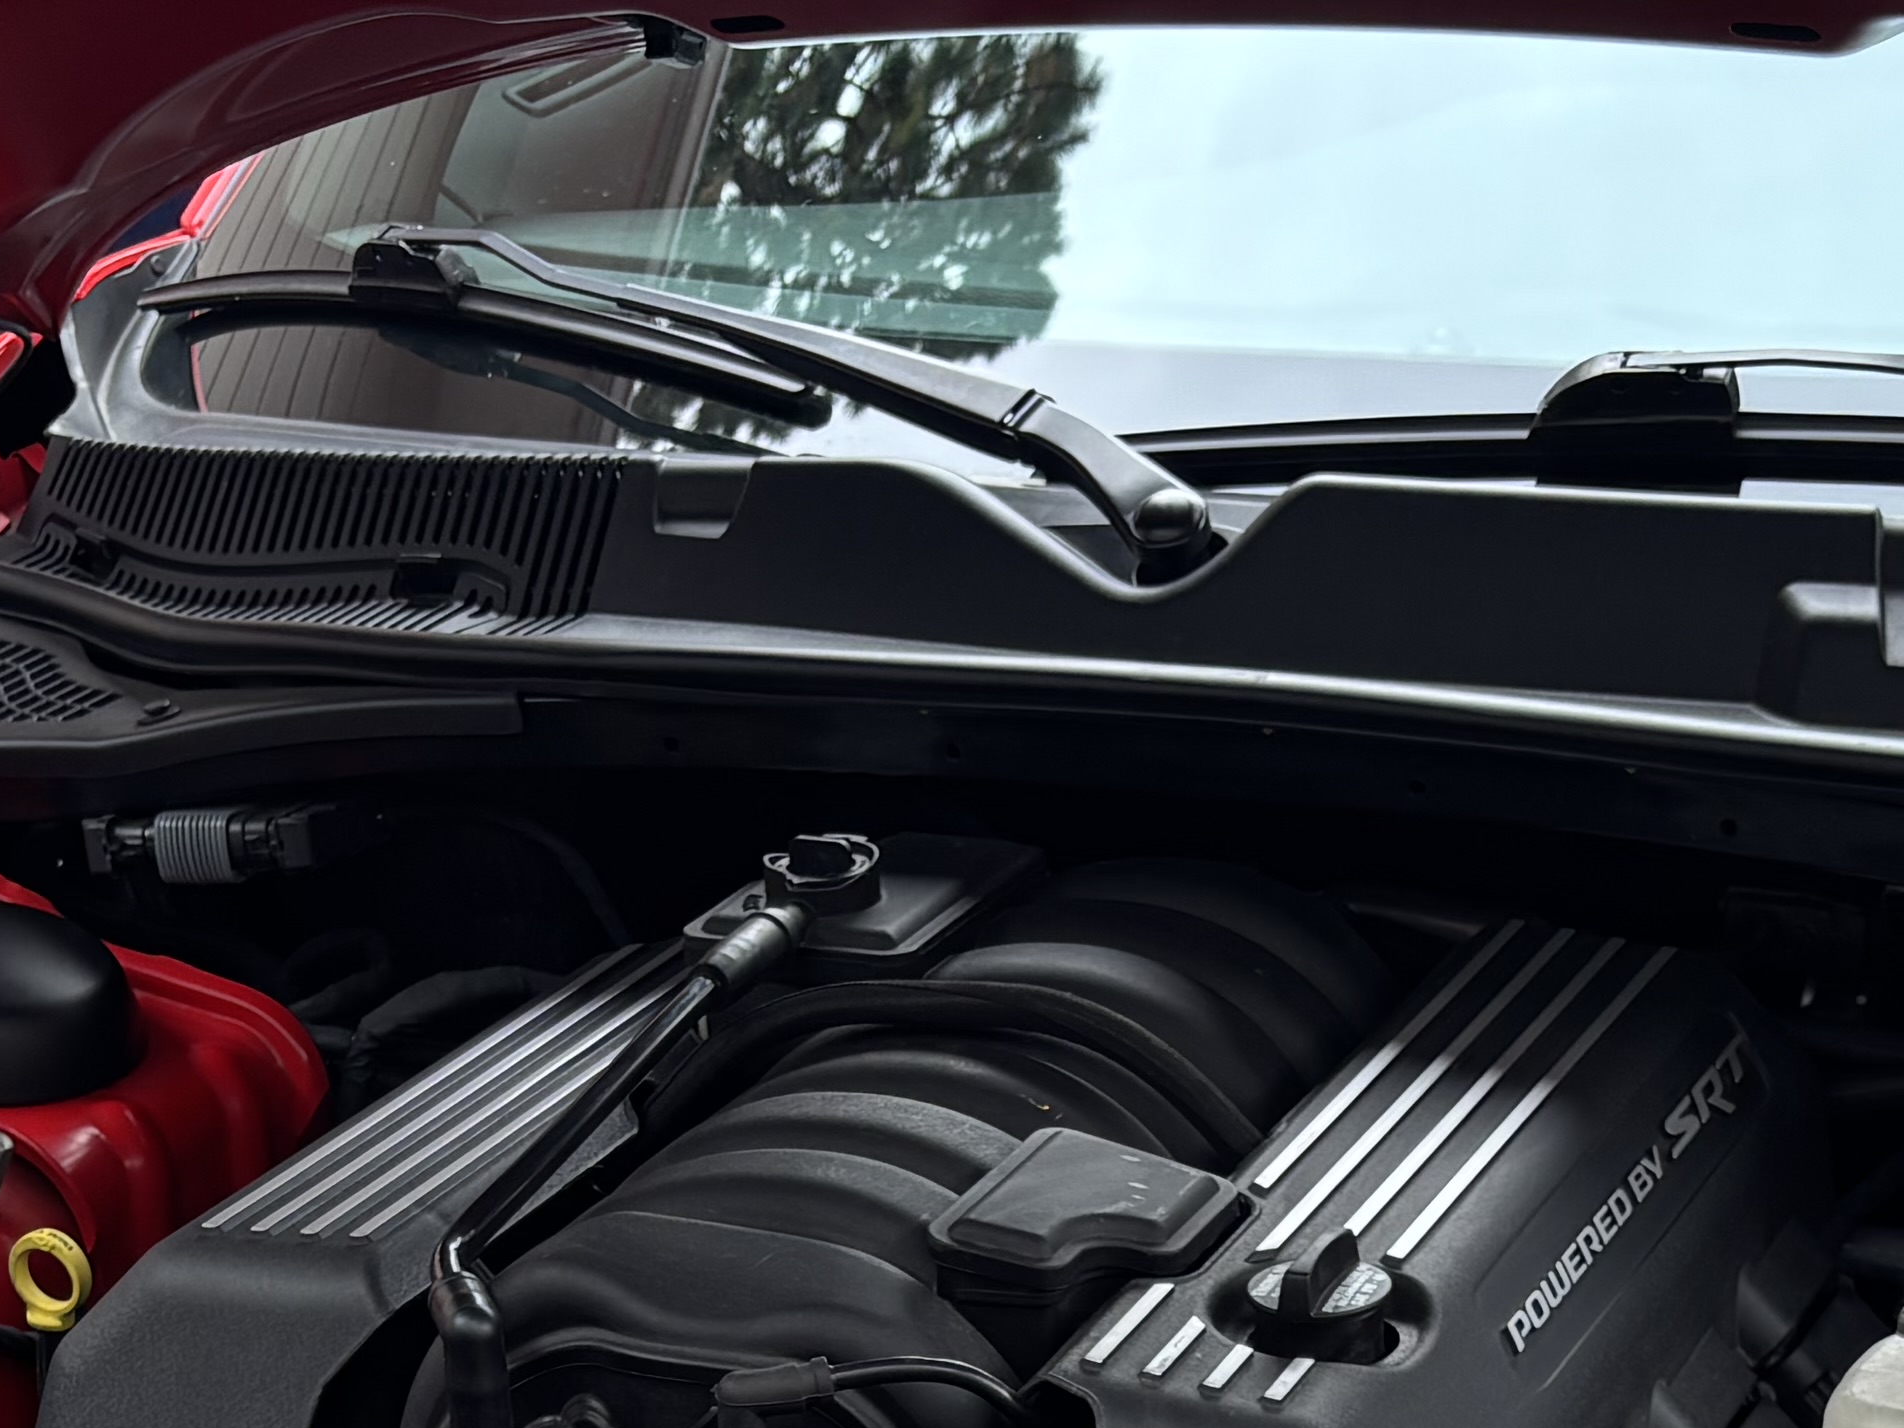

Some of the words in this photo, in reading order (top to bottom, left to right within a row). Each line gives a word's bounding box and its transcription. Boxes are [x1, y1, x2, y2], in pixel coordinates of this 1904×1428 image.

[1507, 1188, 1634, 1353] POWERED
[1627, 1145, 1664, 1203] BY
[1663, 1030, 1746, 1159] SRT
